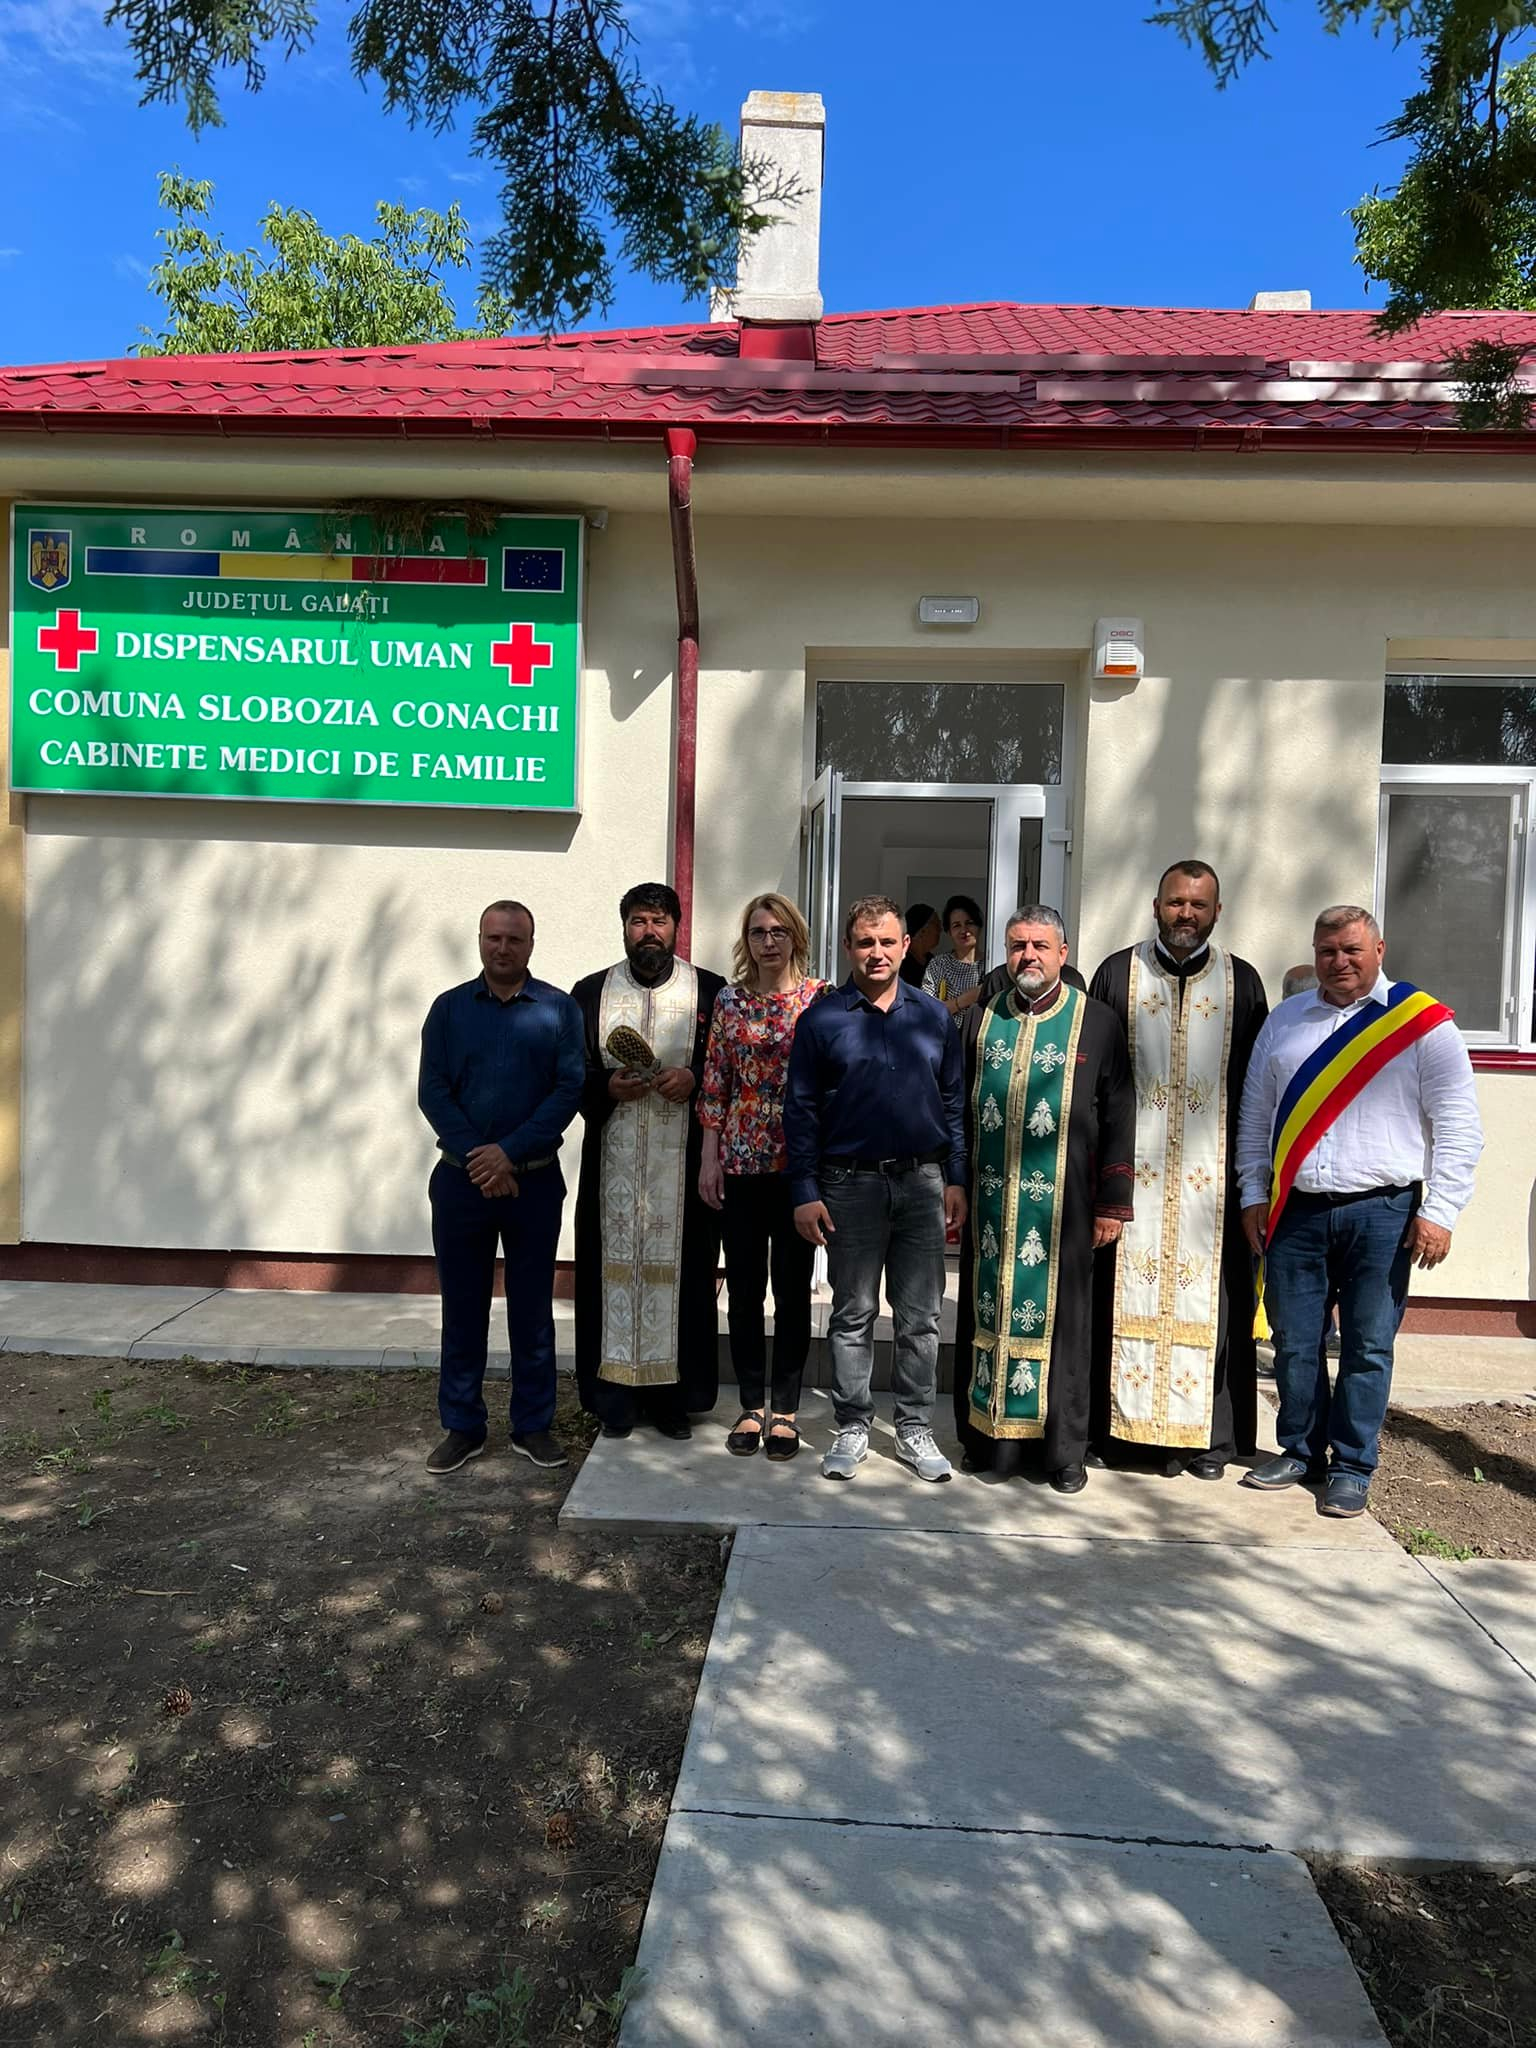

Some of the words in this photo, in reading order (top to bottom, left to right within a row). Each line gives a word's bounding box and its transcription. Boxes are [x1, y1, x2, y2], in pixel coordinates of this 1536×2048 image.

[131, 527, 446, 552] ROMÂNIA
[116, 631, 359, 667] DISPENSARUL
[371, 640, 473, 669] UMAN
[29, 688, 186, 719] COMUNA
[198, 694, 380, 726] SLOBOZIA
[392, 700, 560, 732] CONACHI
[40, 740, 208, 770] CABINETE
[219, 746, 341, 775] MEDICI
[353, 751, 400, 777] DE
[411, 753, 547, 783] FAMILIE
